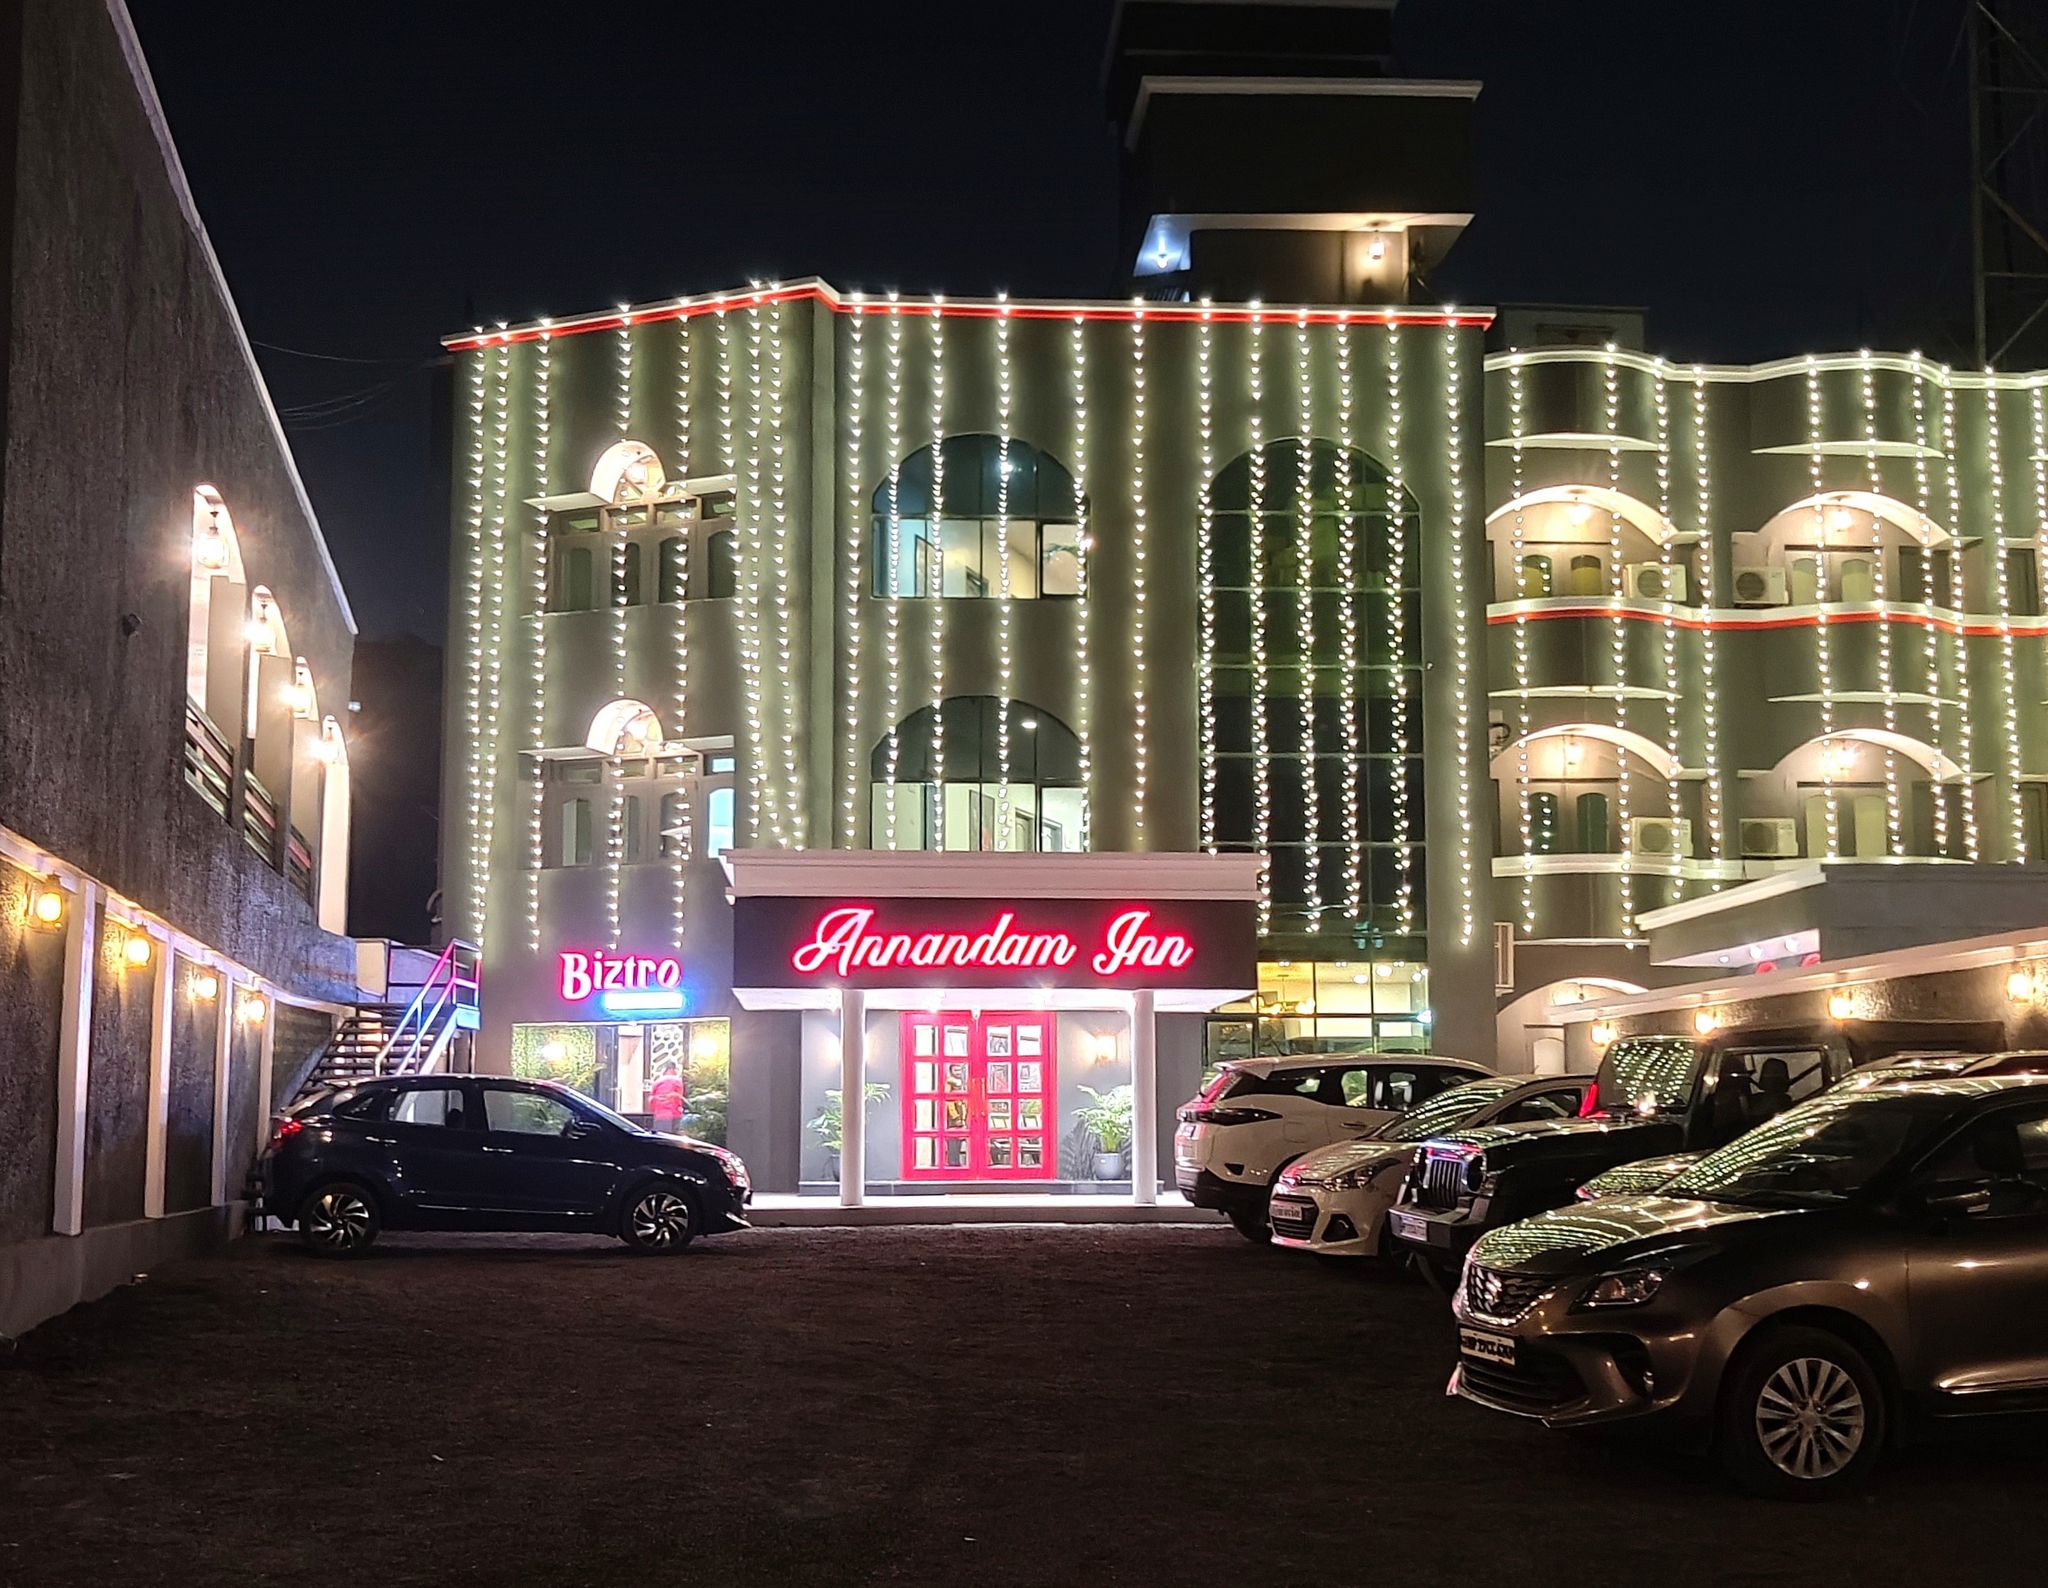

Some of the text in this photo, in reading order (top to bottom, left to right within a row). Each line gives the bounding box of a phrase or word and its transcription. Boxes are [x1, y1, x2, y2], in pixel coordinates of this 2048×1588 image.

[793, 908, 1194, 977] Annandam Inn
[560, 950, 682, 1001] Biztro
